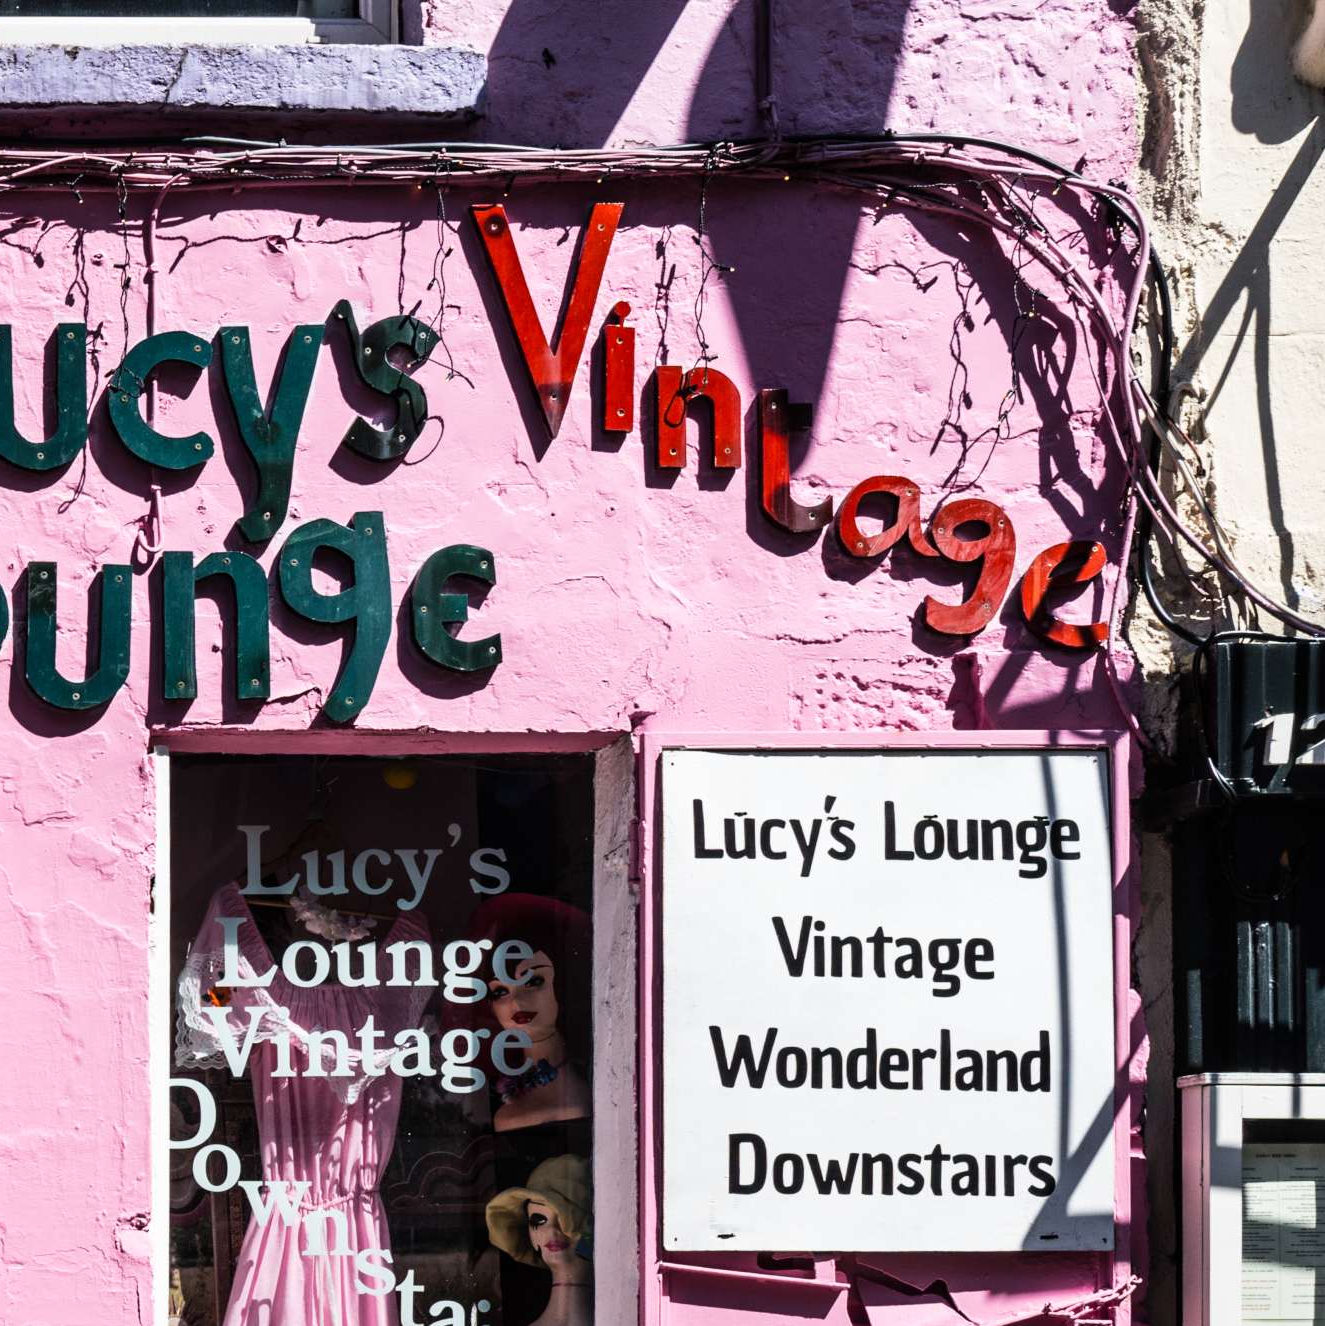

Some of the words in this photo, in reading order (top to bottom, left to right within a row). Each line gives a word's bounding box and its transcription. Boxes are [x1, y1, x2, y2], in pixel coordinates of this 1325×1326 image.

[471, 202, 1109, 648] Vintage
[237, 823, 510, 910] Lucy's
[693, 795, 856, 877] Lucy's
[885, 800, 1081, 878] Lounge
[215, 917, 534, 1004] Lounge
[772, 915, 995, 997] Vintage
[202, 1006, 534, 1094] Vintage
[709, 1025, 1051, 1092] Wonderland
[729, 1133, 1056, 1197] Downstairs
